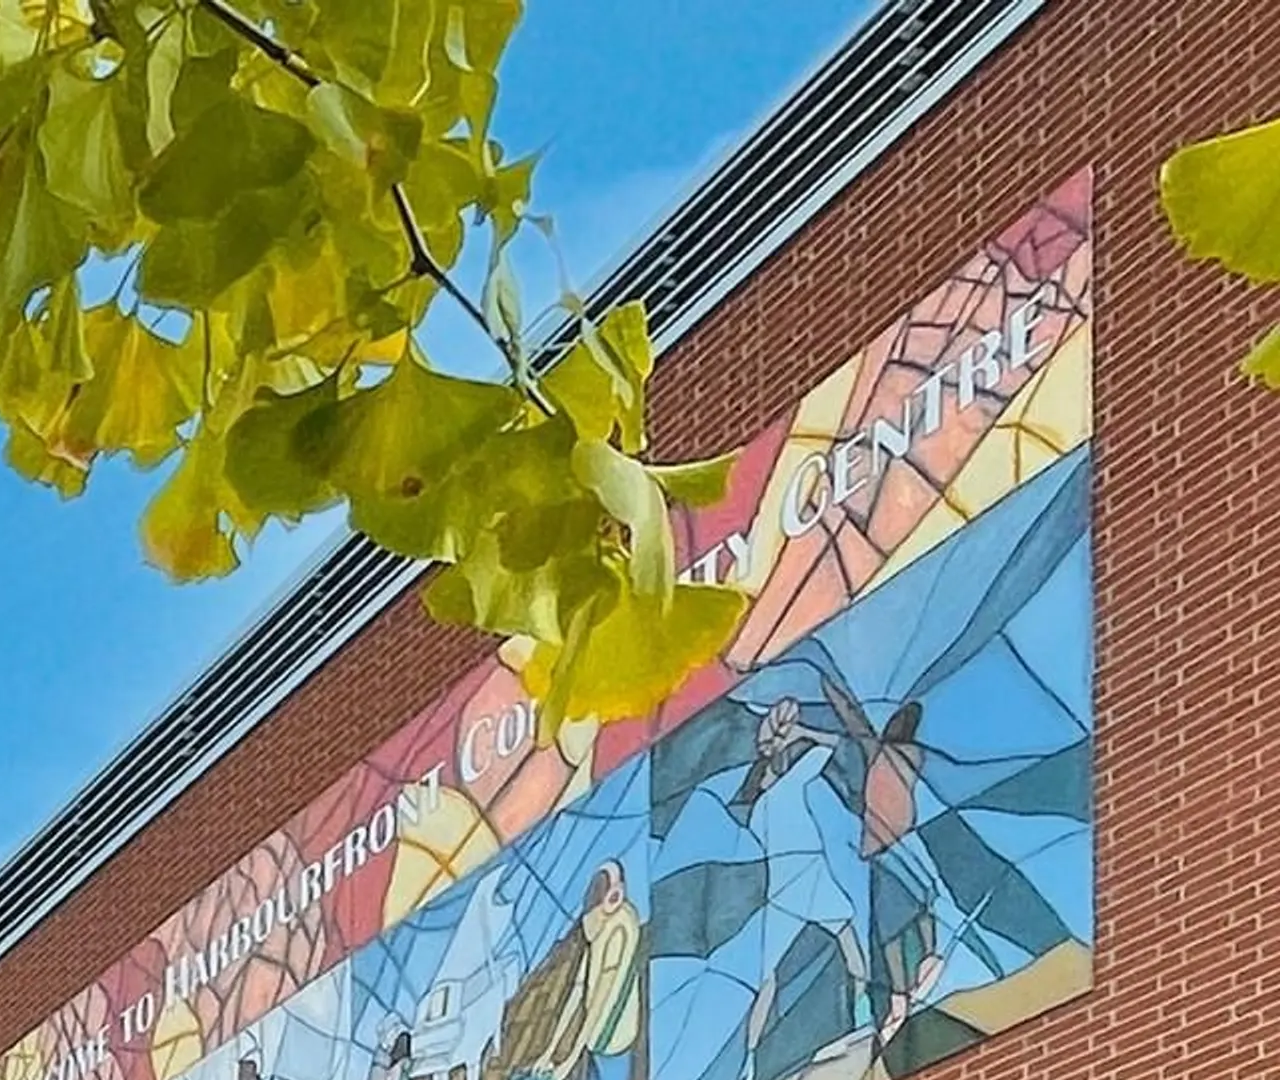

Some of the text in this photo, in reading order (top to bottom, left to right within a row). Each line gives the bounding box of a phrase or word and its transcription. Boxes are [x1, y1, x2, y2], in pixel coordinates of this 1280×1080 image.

[119, 992, 155, 1043] TO
[164, 760, 446, 1010] HARBOURFRONT
[780, 289, 1052, 538] CENTRE
